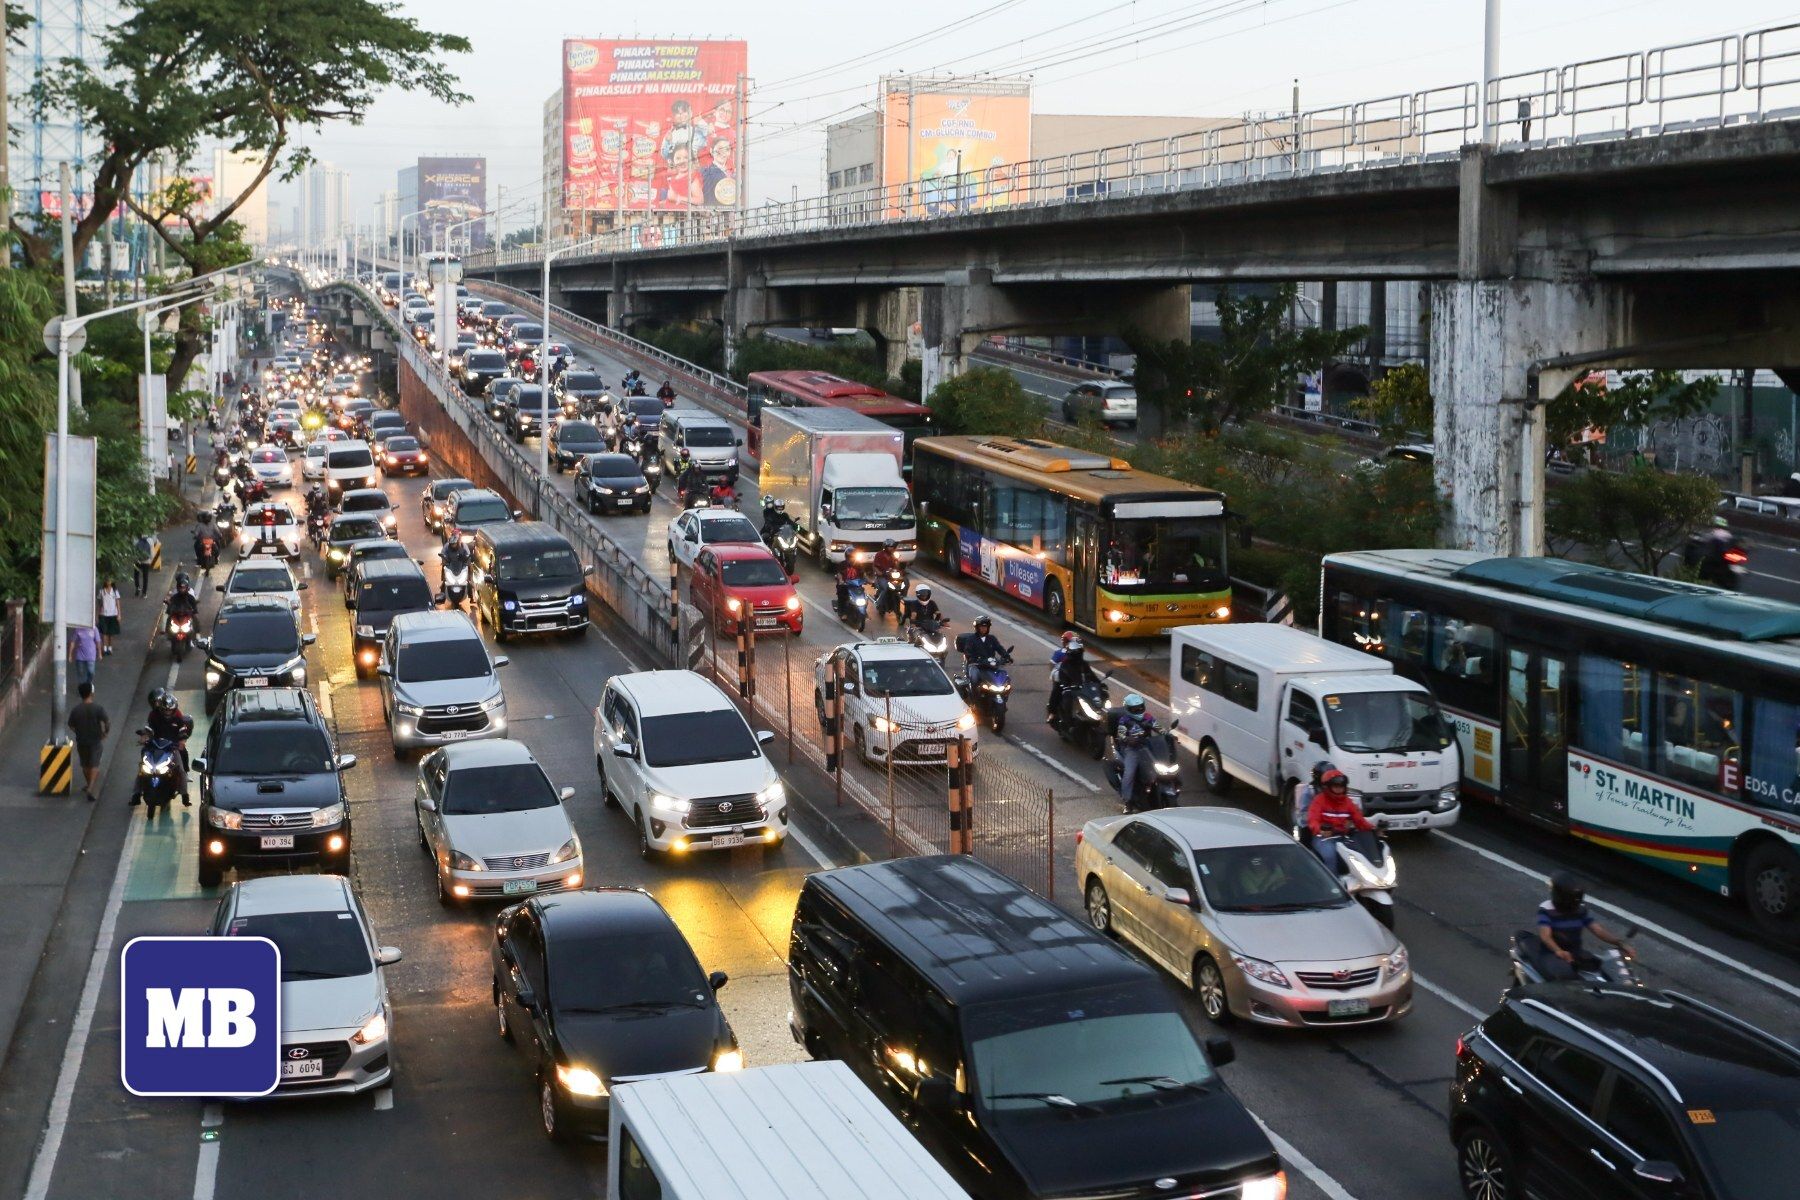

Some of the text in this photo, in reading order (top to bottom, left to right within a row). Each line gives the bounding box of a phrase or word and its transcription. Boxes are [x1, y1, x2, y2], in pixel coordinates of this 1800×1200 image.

[572, 56, 594, 68] Juicy
[575, 82, 737, 97] PINAKASULIT NA INUULIT-ULIT!
[1009, 560, 1034, 585] billease
[1723, 764, 1738, 790] E
[1744, 775, 1778, 799] EDSA
[1595, 769, 1695, 820] ST. MARTIN
[1595, 790, 1604, 801] of
[299, 1062, 321, 1073] 6094
